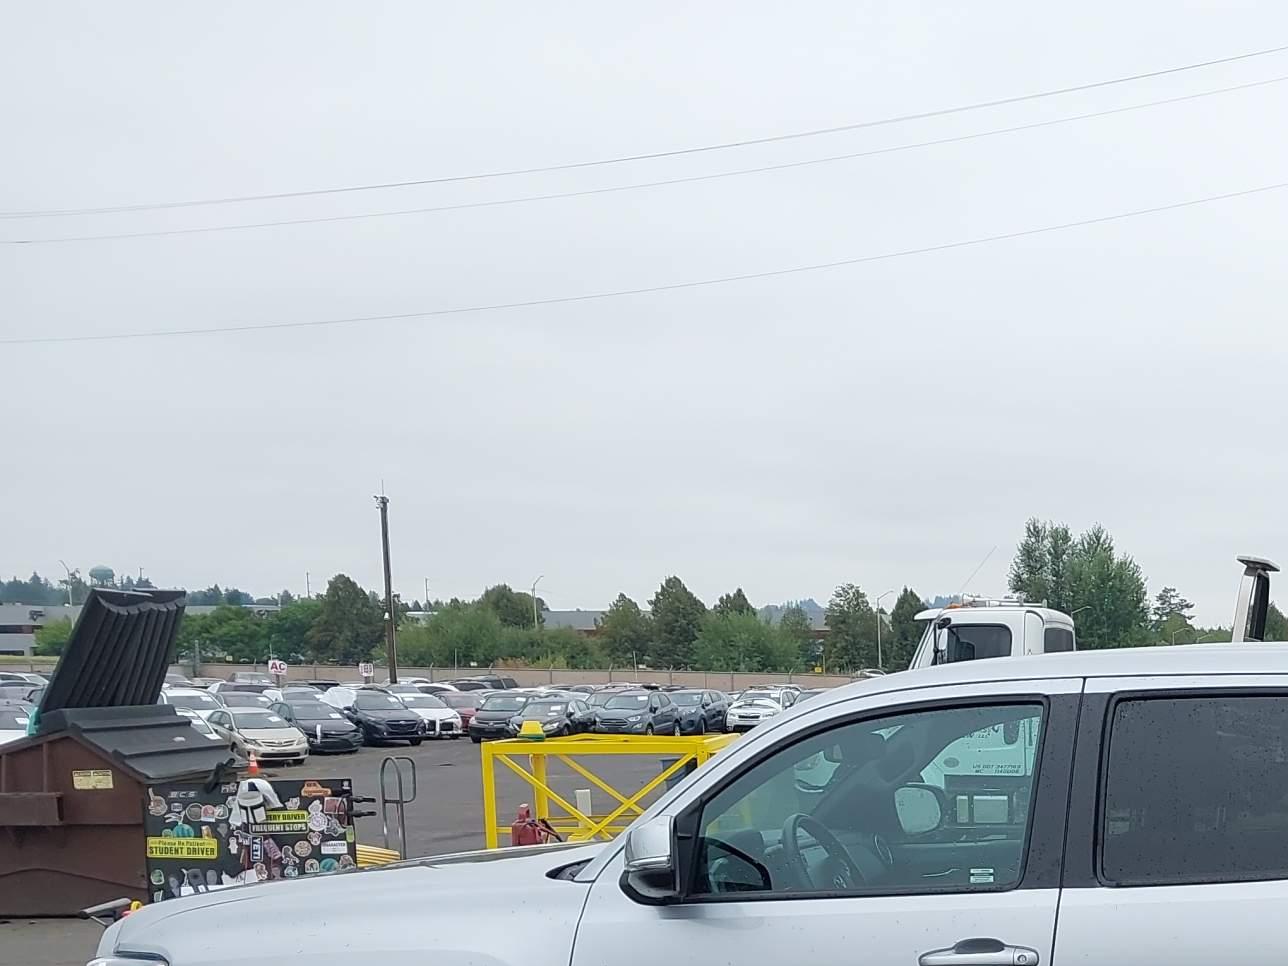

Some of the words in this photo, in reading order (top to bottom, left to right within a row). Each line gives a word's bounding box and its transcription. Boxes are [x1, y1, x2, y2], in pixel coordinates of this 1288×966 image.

[270, 662, 286, 671] AC
[282, 813, 306, 821] DRIVER
[285, 823, 307, 831] STOPS
[149, 846, 184, 855] STUDENT
[186, 847, 215, 856] DRIVER
[252, 837, 261, 860] YETI
